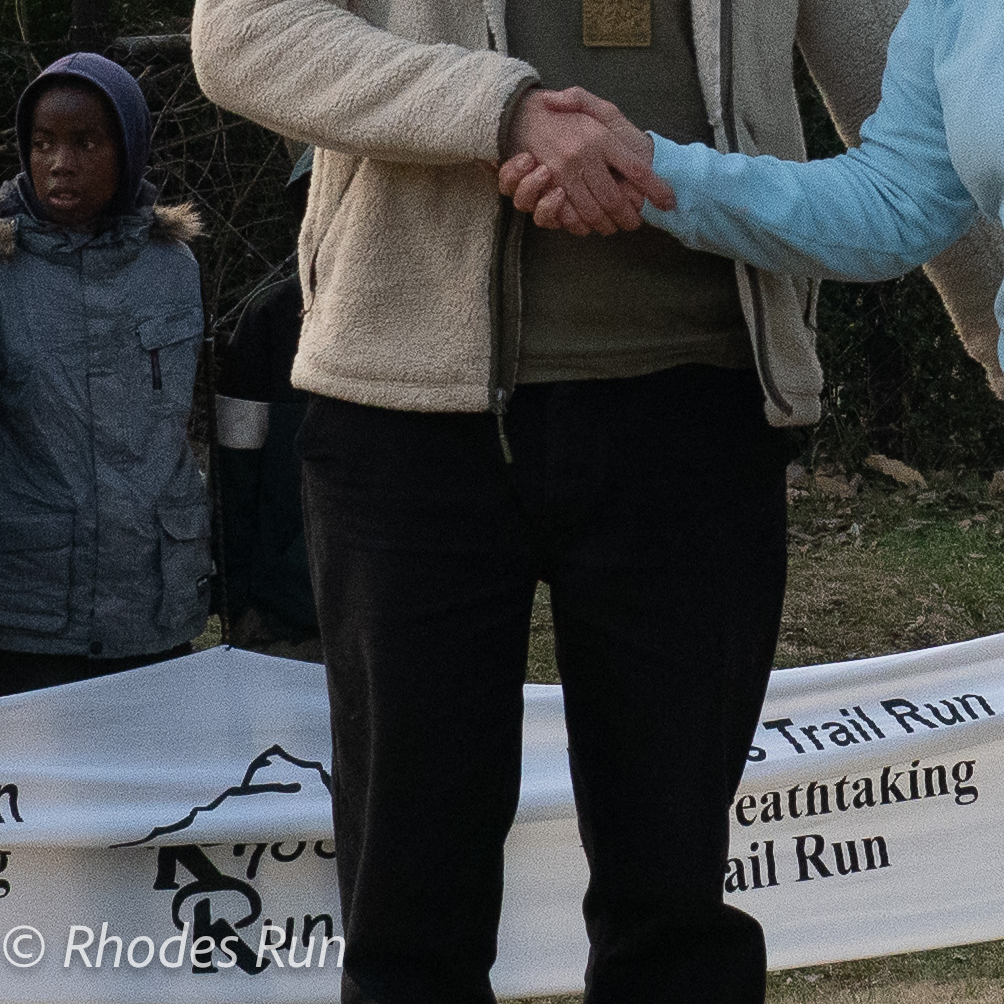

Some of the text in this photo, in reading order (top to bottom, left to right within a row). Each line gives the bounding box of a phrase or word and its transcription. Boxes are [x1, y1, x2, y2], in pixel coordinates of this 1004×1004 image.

[762, 694, 995, 754] Trail Run
[734, 759, 979, 827] eathtaking
[724, 834, 891, 893] ail Run
